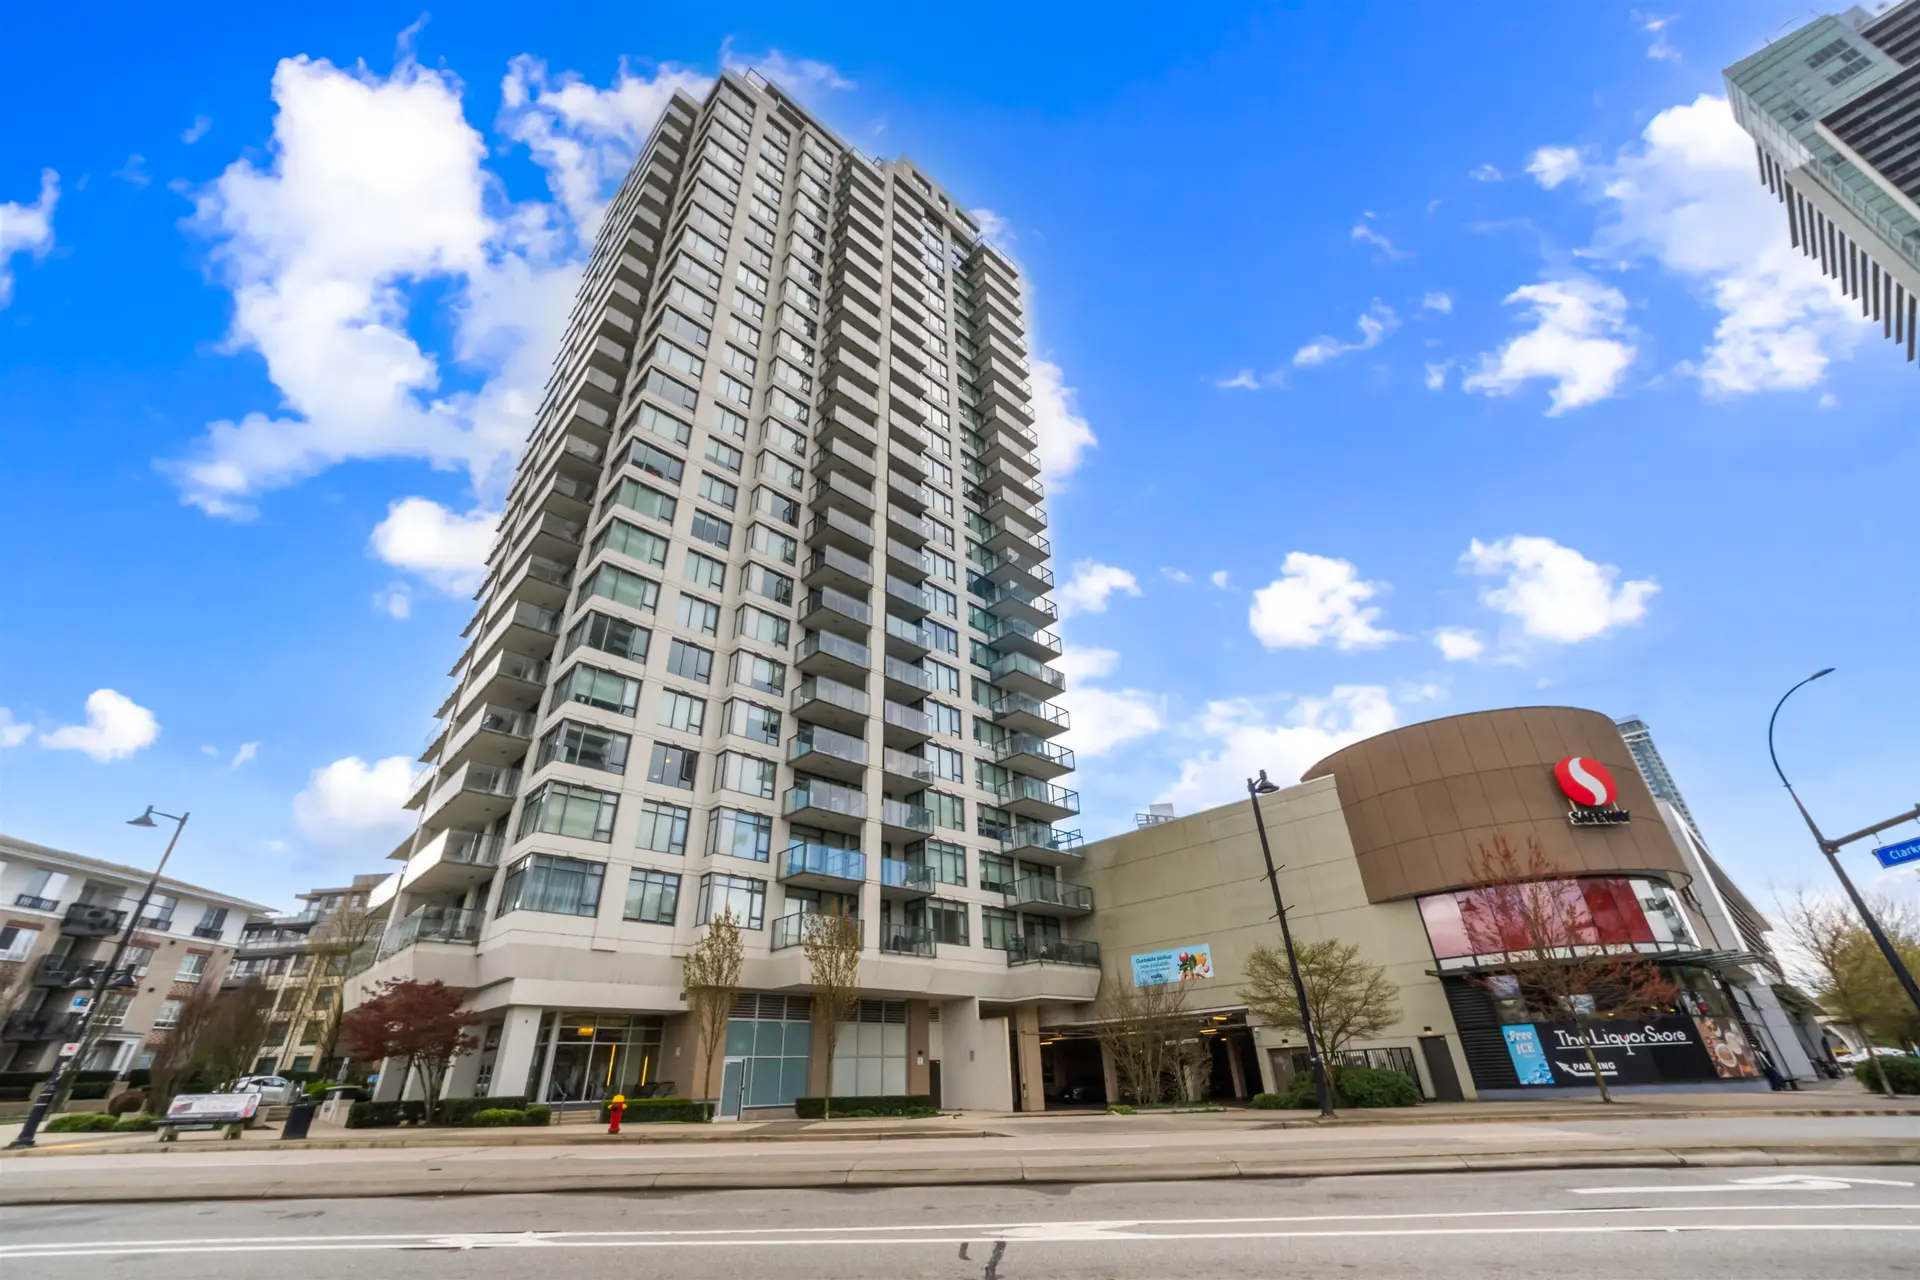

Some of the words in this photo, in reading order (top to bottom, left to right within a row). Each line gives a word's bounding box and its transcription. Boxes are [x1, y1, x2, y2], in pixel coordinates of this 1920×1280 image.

[1508, 1030, 1533, 1042] Free
[1589, 1028, 1646, 1049] Liquor
[1644, 1025, 1687, 1042] Store
[1515, 1042, 1536, 1054] ICE
[1572, 1061, 1616, 1072] PARING
